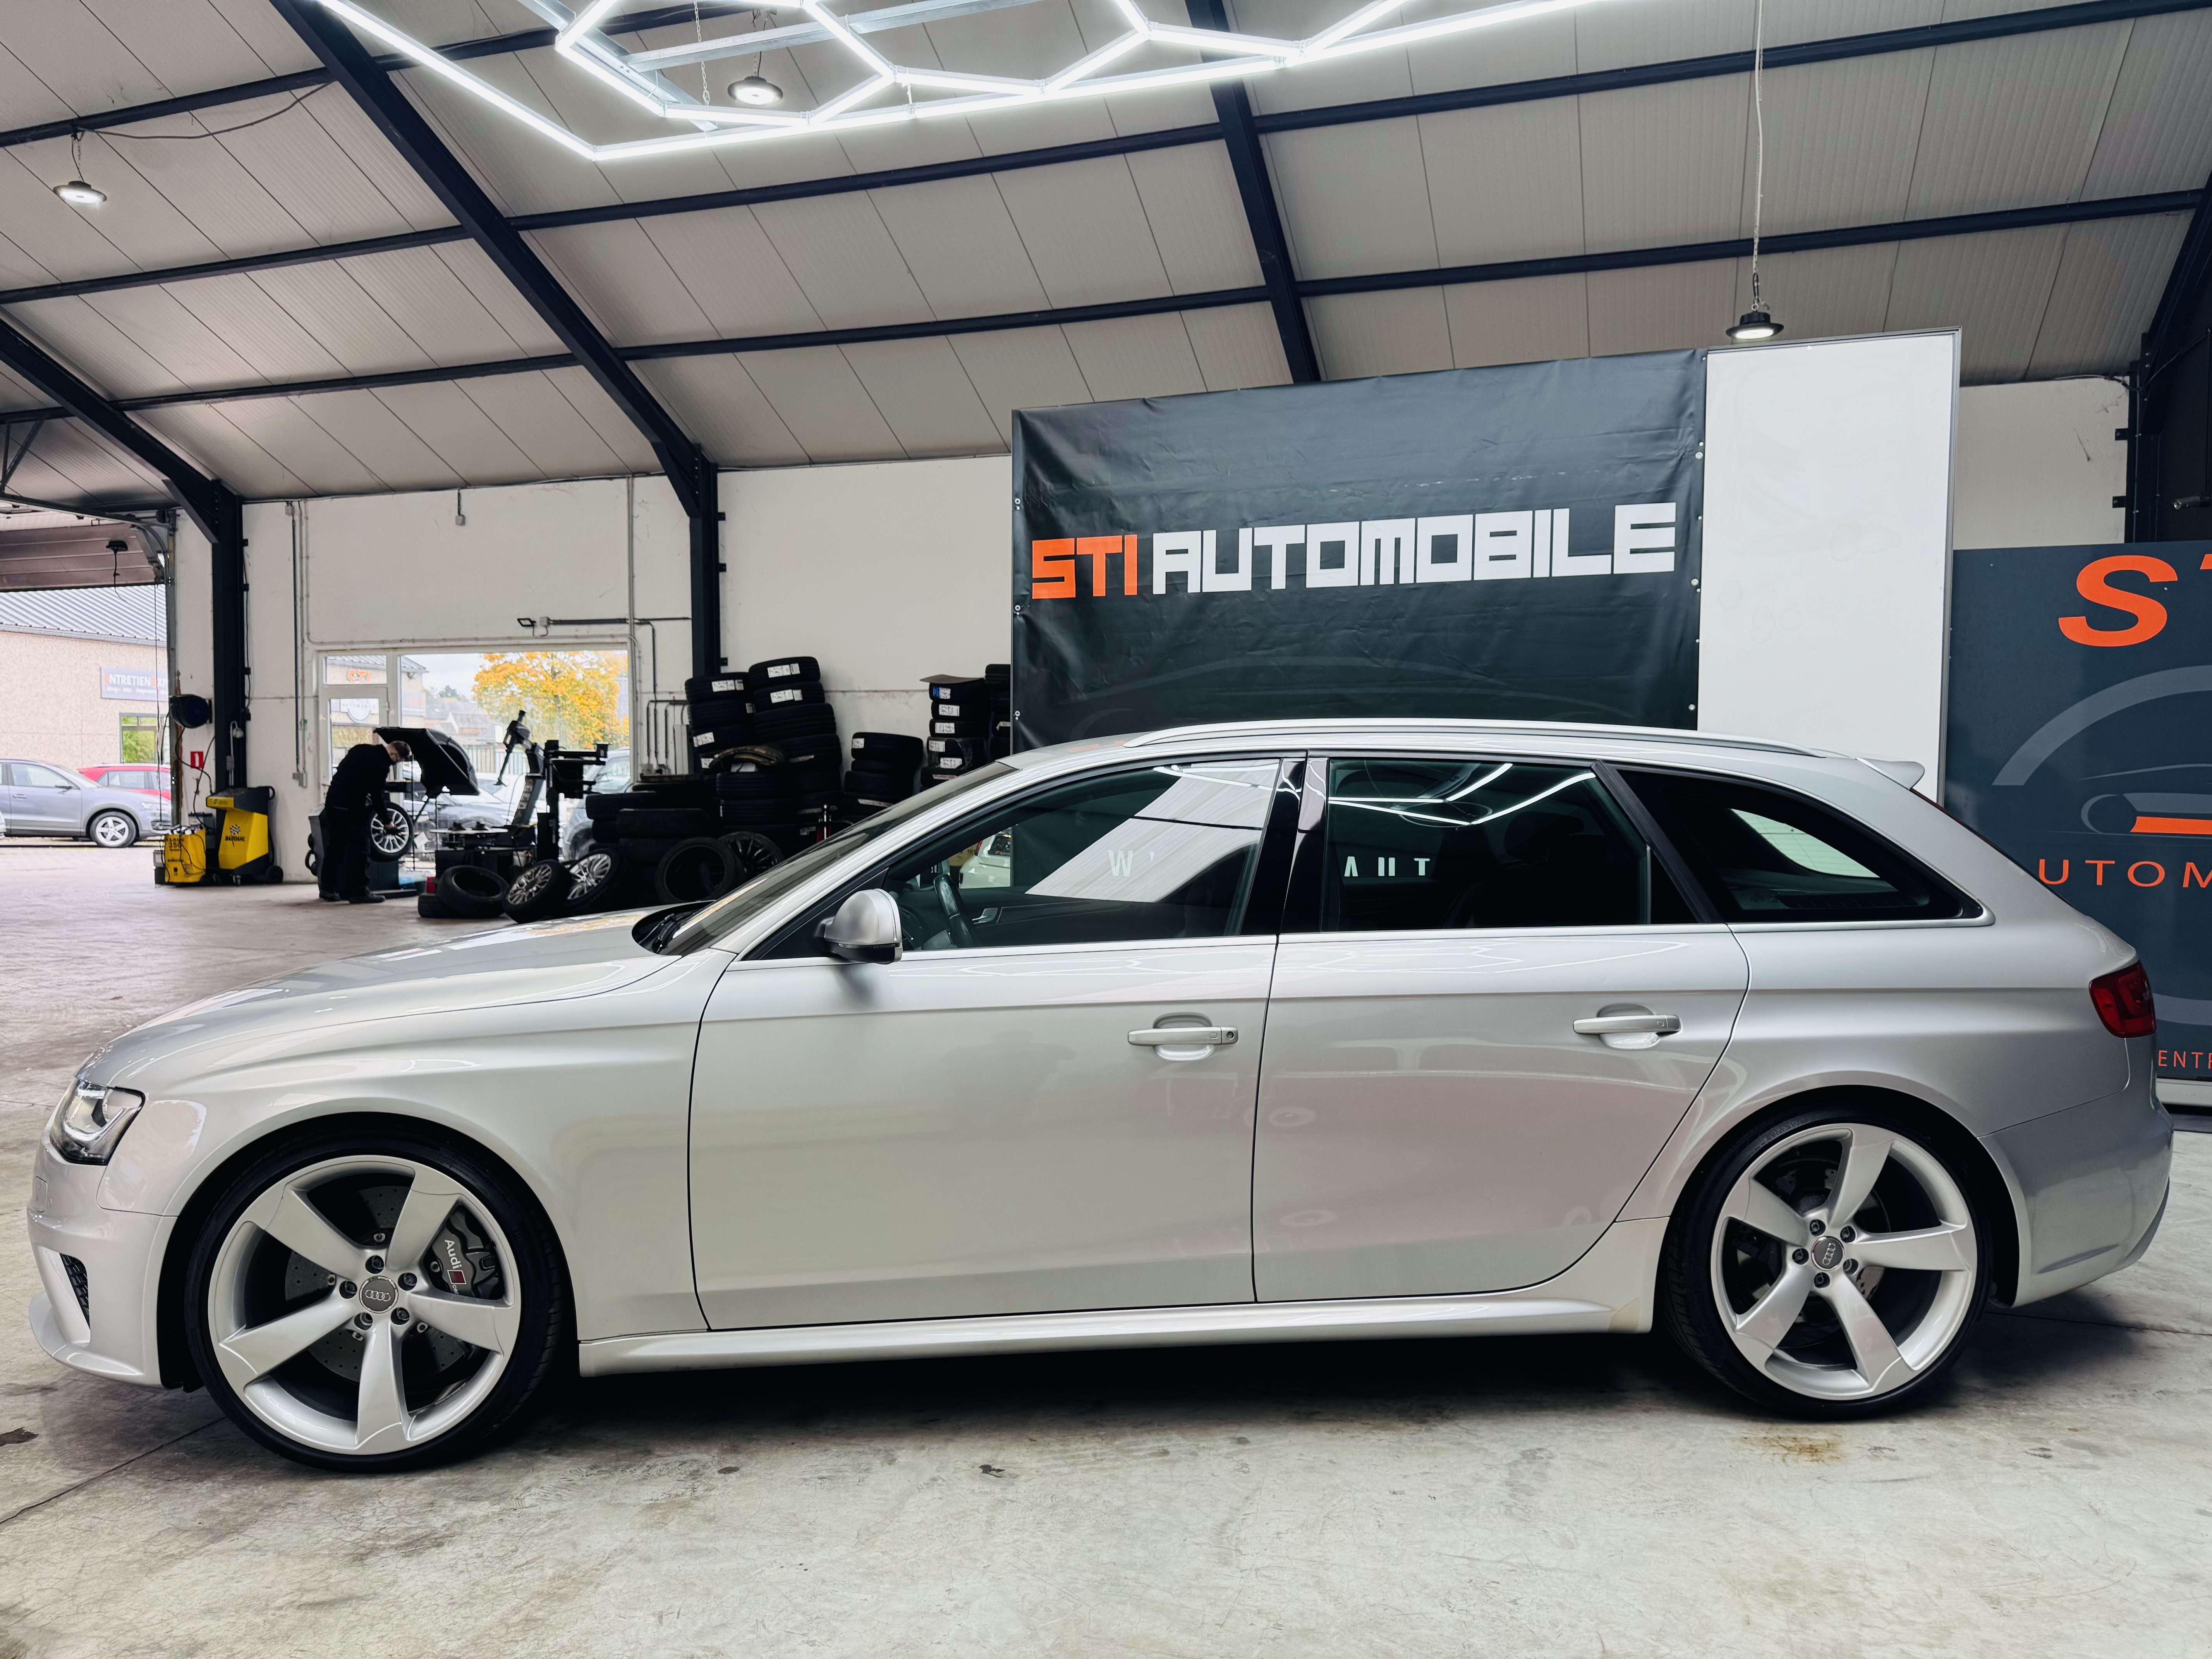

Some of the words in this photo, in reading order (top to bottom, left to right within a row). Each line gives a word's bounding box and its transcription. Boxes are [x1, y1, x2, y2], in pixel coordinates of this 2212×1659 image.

[1032, 535, 1138, 599] STI
[1152, 502, 1676, 594] AUTOMOBILE
[2059, 554, 2212, 647] S
[104, 673, 151, 687] ENTRETIEN
[445, 1239, 462, 1269] Audi
